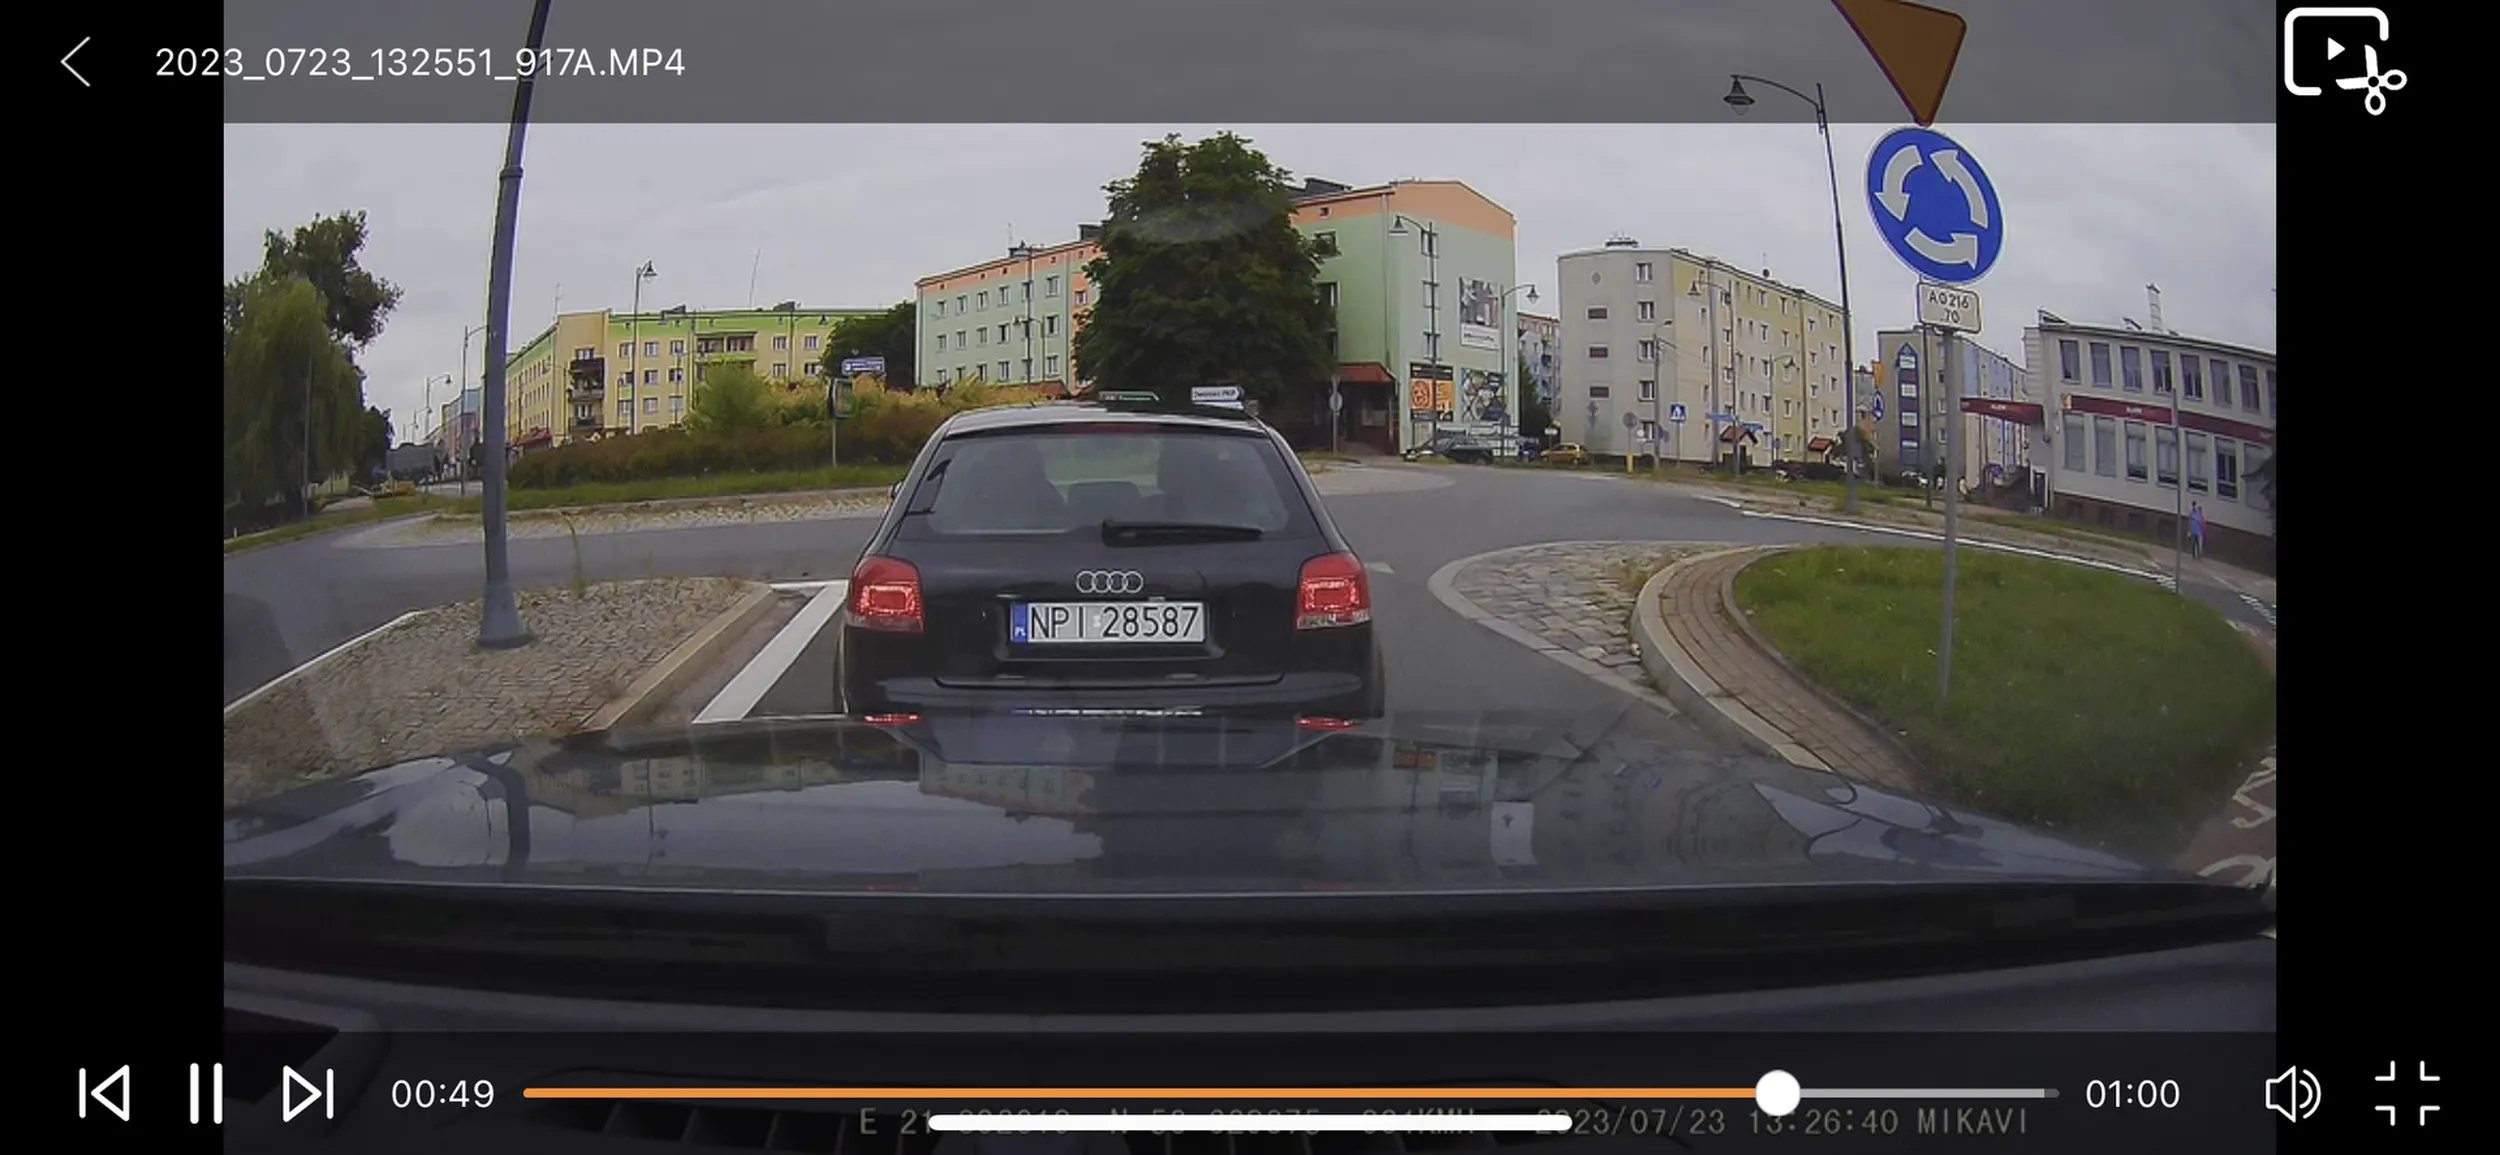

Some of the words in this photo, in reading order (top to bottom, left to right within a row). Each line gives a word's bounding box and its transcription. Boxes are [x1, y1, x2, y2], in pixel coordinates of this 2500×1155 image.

[1928, 290, 1969, 309] A0216
[1031, 606, 1084, 639] NPI
[1102, 606, 1199, 638] 28587
